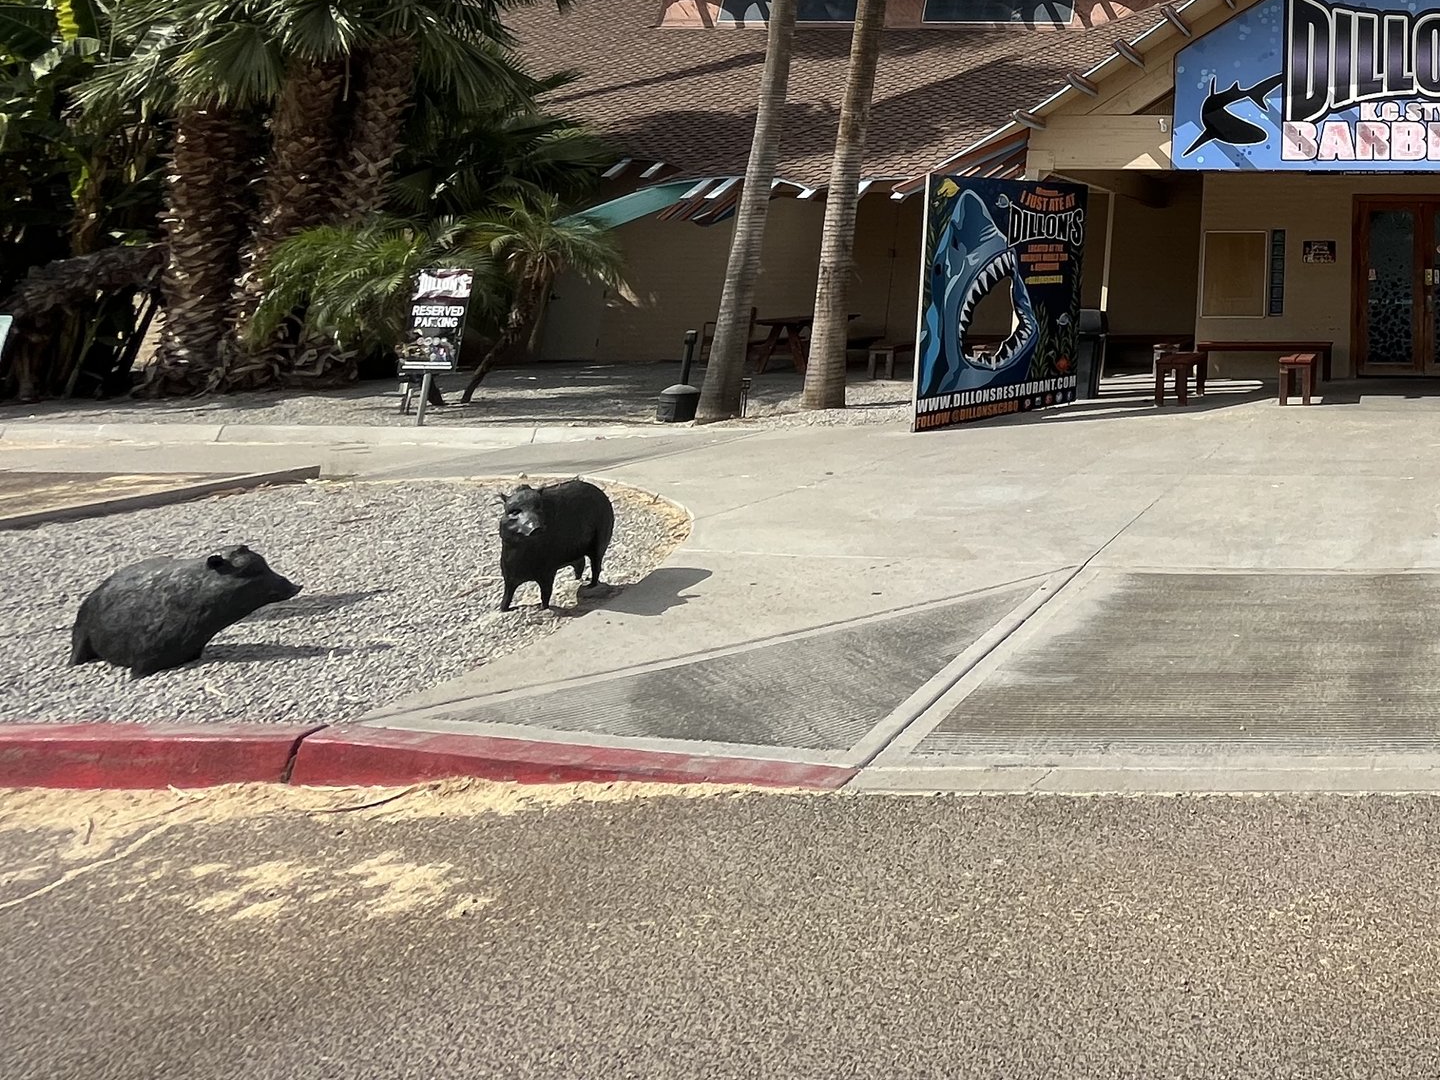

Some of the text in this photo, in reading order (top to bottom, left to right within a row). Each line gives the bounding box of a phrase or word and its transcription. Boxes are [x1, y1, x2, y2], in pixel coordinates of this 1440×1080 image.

[1020, 190, 1027, 203] I
[1025, 193, 1049, 211] JUST
[1049, 197, 1065, 211] ATE
[1065, 193, 1075, 208] AT
[1008, 205, 1084, 247] DILLON'S
[412, 305, 465, 317] RESERVED
[414, 317, 459, 328] PARKING
[917, 375, 1077, 414] WWW.DILLONSRESTAURANT.COM
[916, 410, 951, 429] FOLLOW
